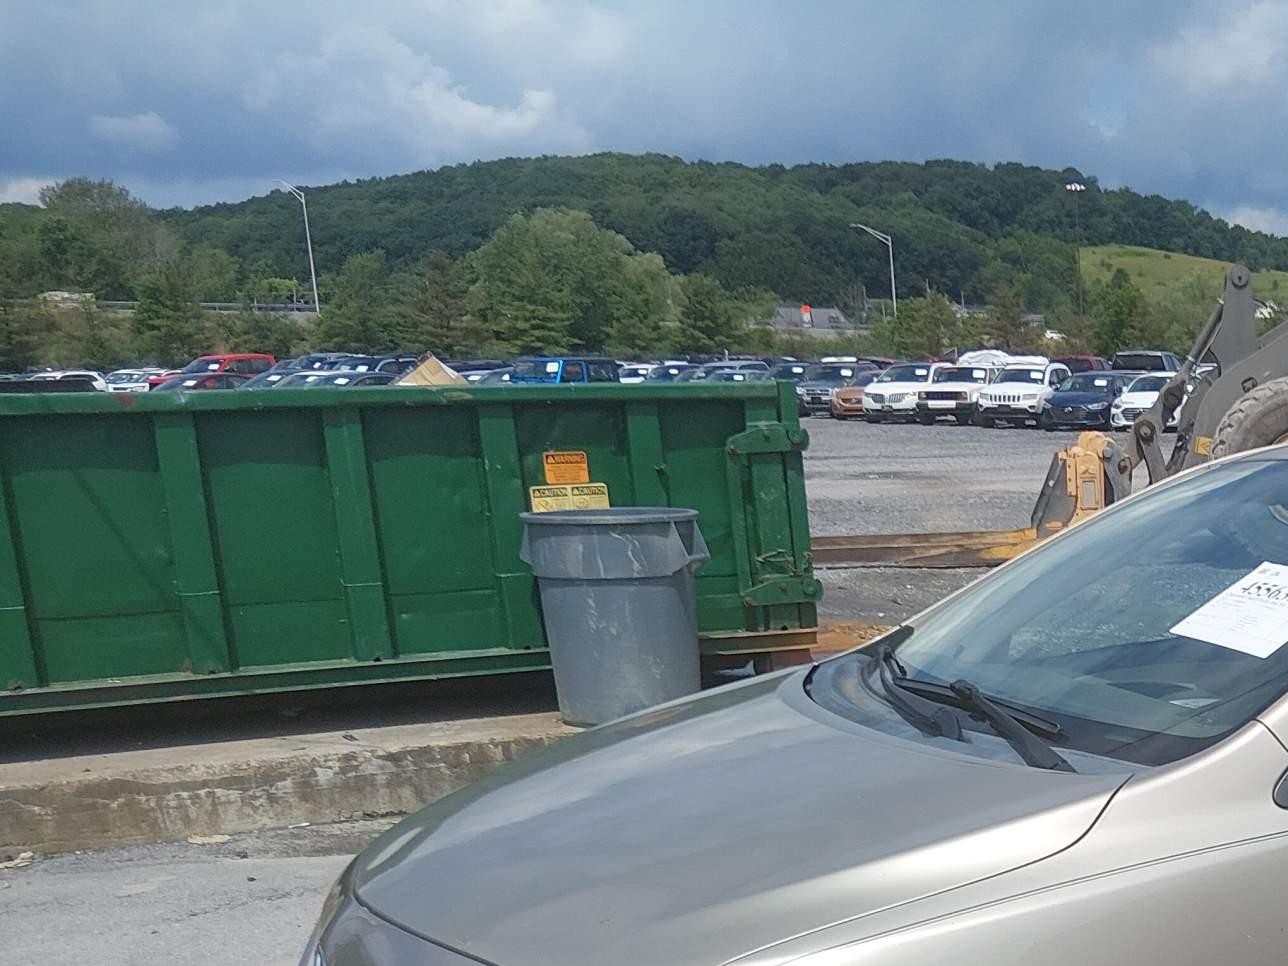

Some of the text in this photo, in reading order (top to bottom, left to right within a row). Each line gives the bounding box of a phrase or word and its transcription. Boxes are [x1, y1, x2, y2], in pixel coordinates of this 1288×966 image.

[554, 455, 585, 464] WARNING
[540, 488, 568, 497] CAUTION
[580, 487, 605, 496] CAUTION
